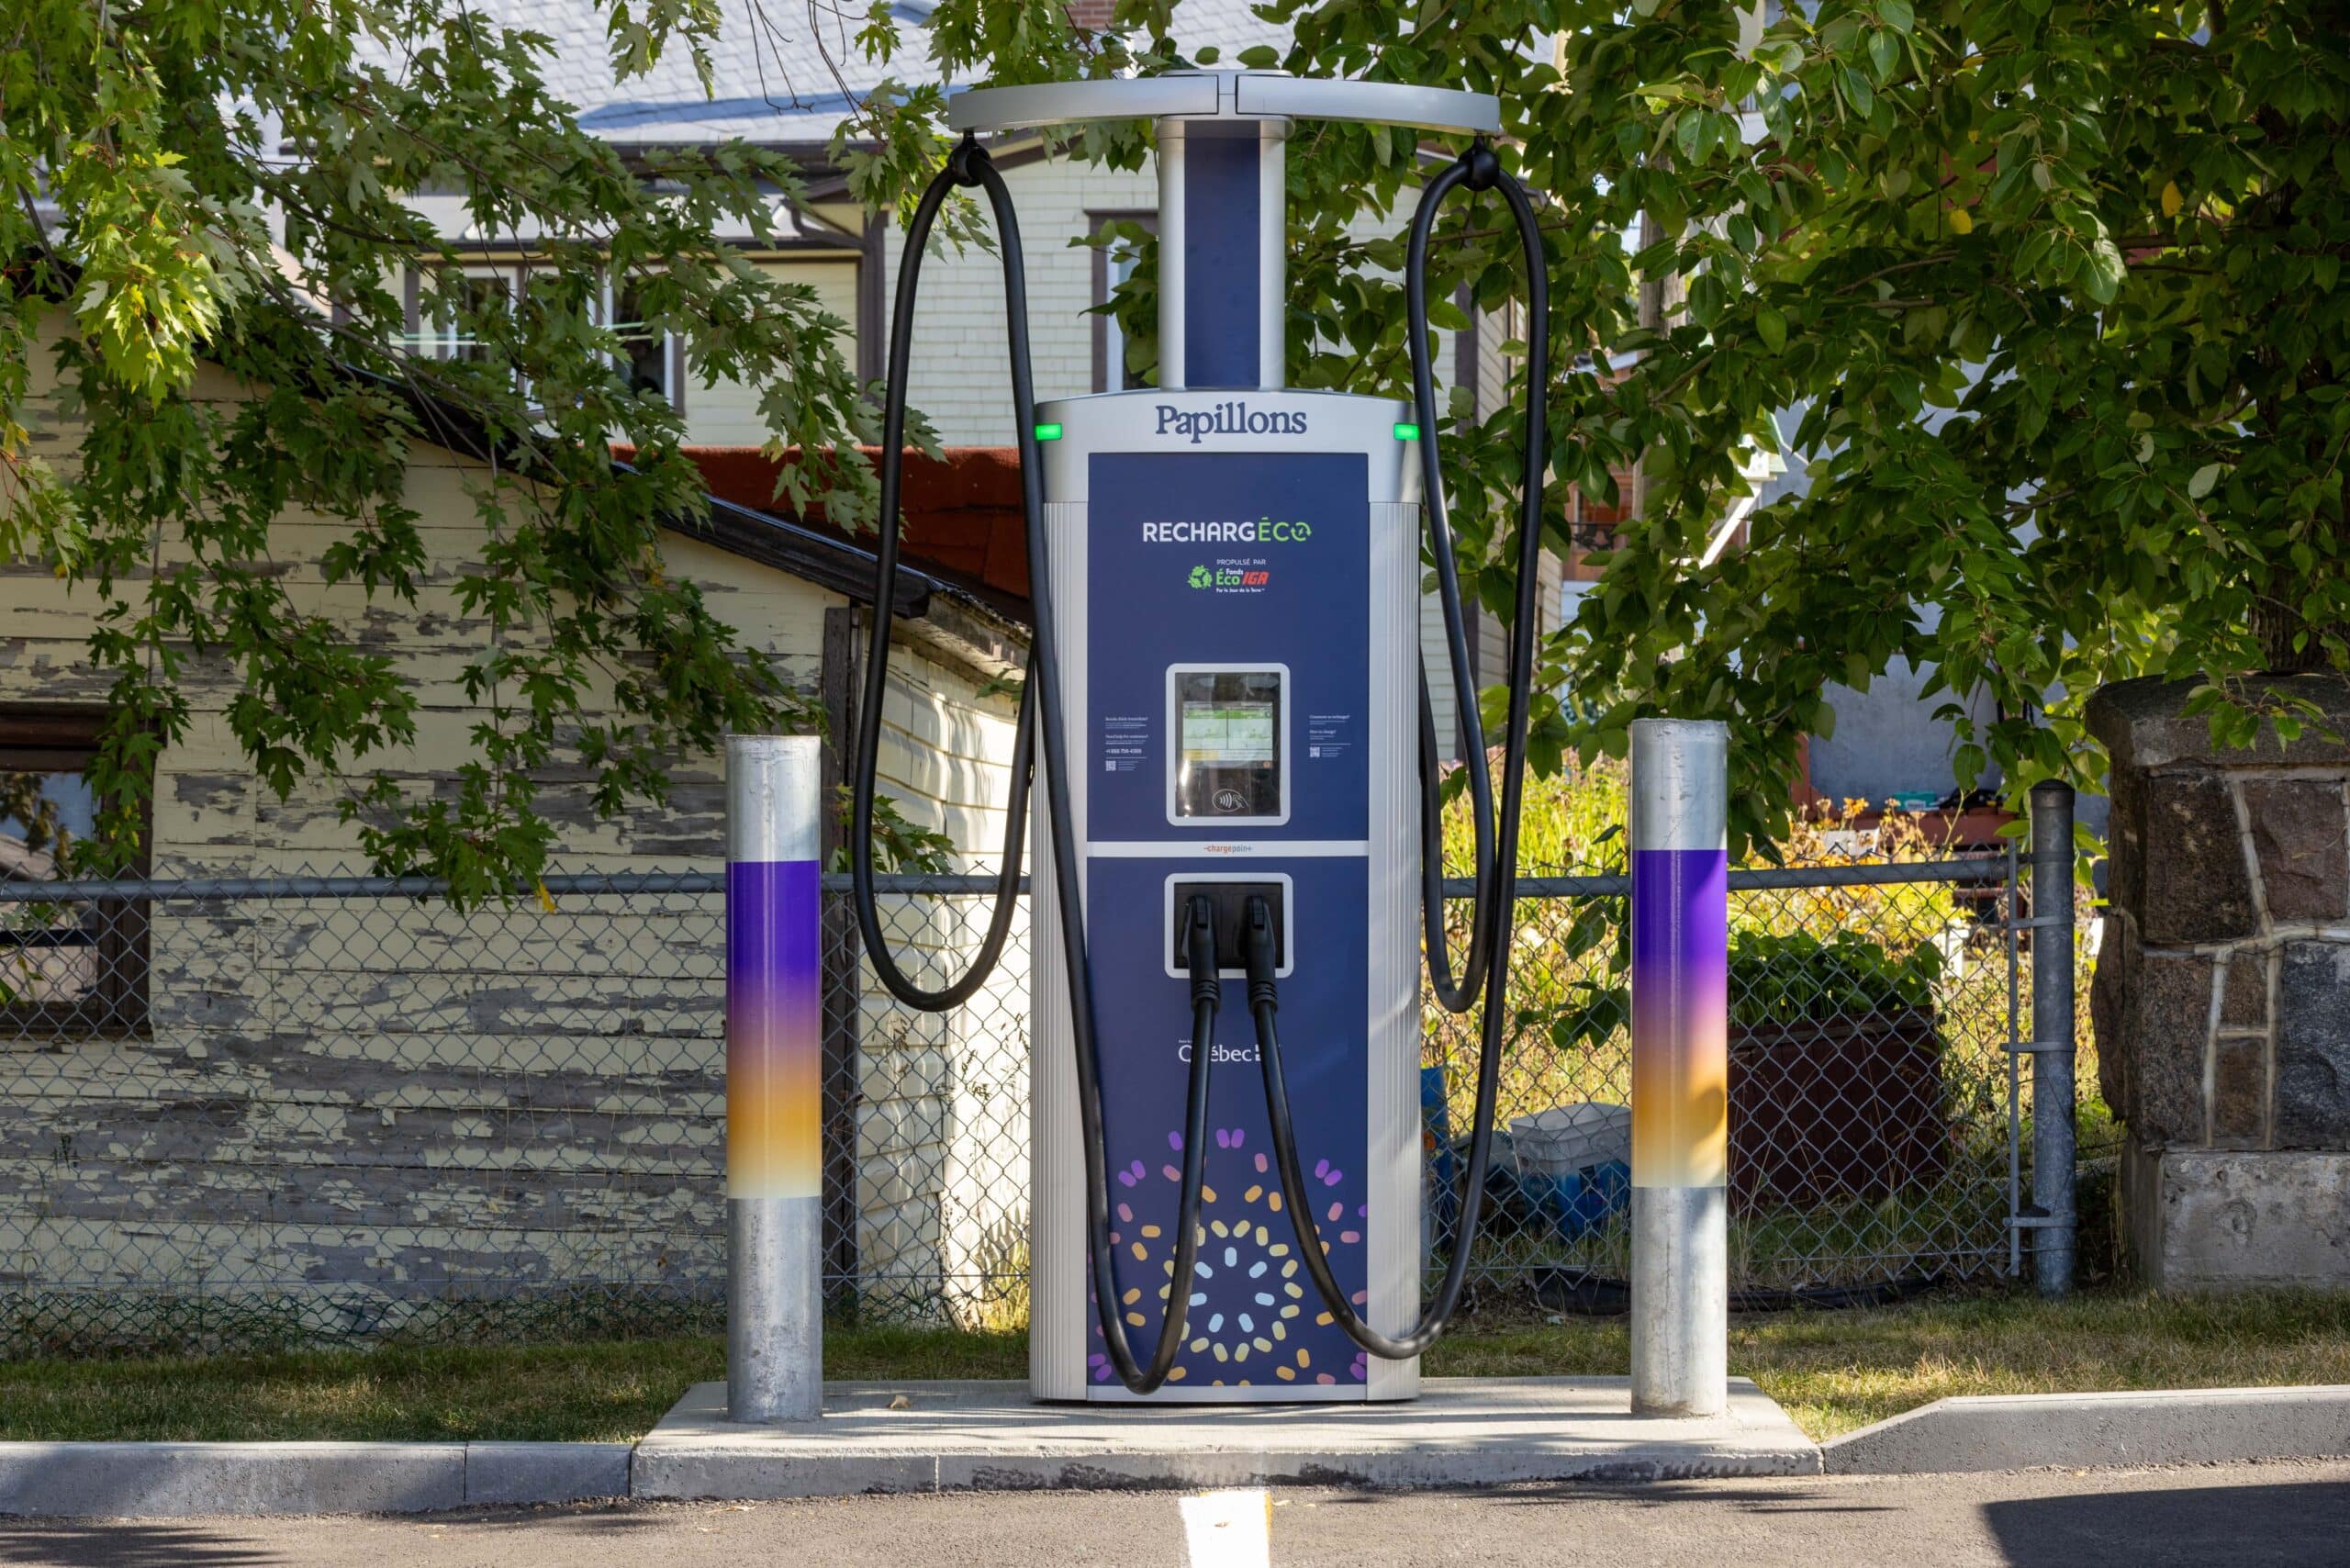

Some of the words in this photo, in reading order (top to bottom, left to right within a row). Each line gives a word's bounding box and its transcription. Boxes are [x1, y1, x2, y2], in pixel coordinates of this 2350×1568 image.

[1155, 401, 1307, 443] Papillons
[1215, 568, 1240, 585] Éco
[1242, 571, 1270, 585] IGA
[1178, 1044, 1252, 1063] Qébec
